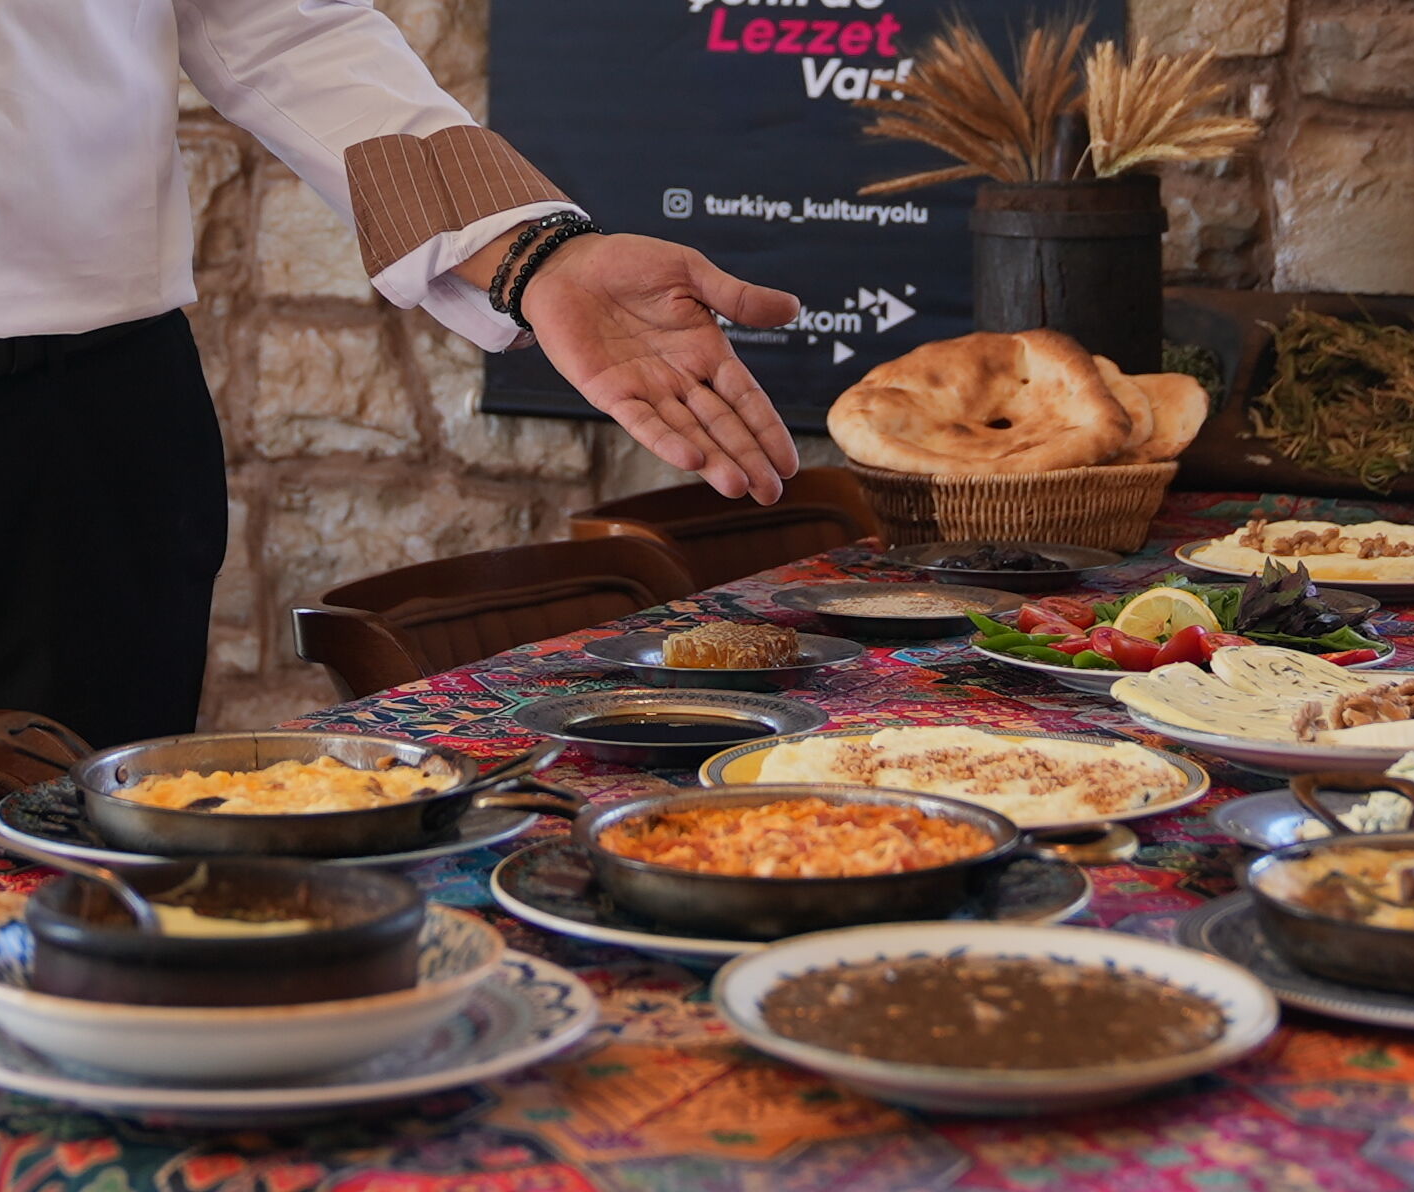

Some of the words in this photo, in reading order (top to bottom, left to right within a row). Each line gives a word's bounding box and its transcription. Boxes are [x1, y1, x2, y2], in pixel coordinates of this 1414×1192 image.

[706, 7, 902, 57] Lezzet
[801, 57, 915, 100] Var!
[704, 194, 928, 226] turkiye_kulturyolu
